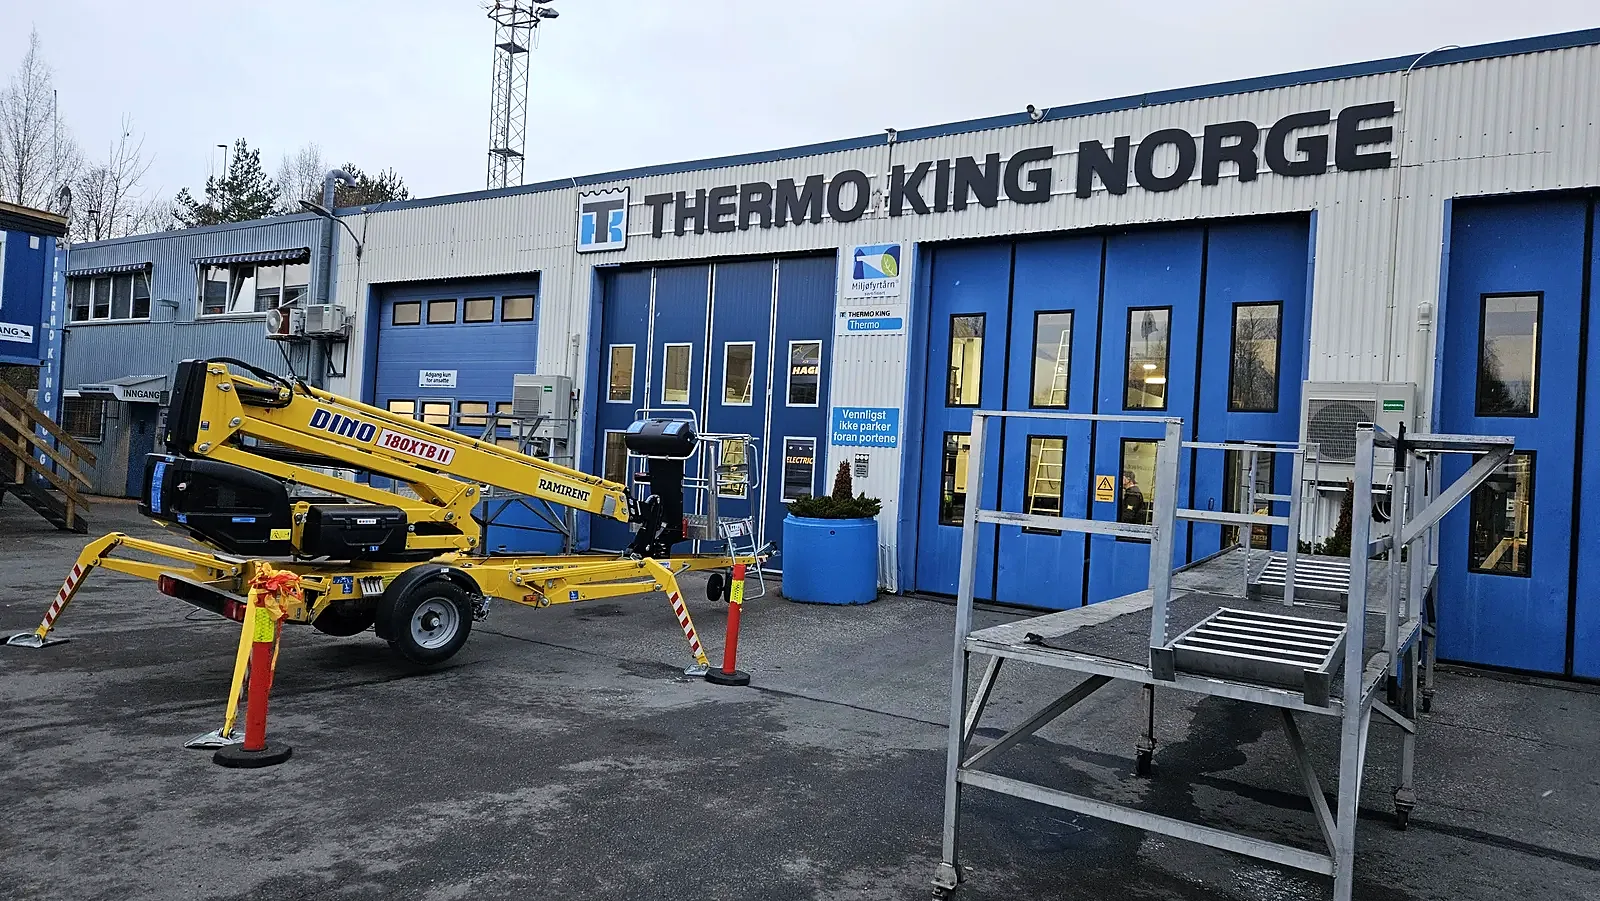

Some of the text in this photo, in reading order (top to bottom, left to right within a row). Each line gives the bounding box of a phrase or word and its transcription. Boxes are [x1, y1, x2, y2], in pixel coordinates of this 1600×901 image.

[644, 101, 1396, 239] THERMO KING NORGE
[851, 280, 895, 291] Miljøfyrtårn
[848, 310, 874, 318] THERMO
[849, 320, 880, 330] Thermo
[44, 347, 54, 403] KING
[123, 389, 160, 399] INNGANG
[842, 409, 886, 422] Vennligst
[839, 420, 892, 433] ikke parker
[309, 408, 377, 443] DINO
[385, 433, 437, 459] 180XTB
[833, 431, 896, 444] foran portene
[538, 478, 591, 502] RAMIRENT
